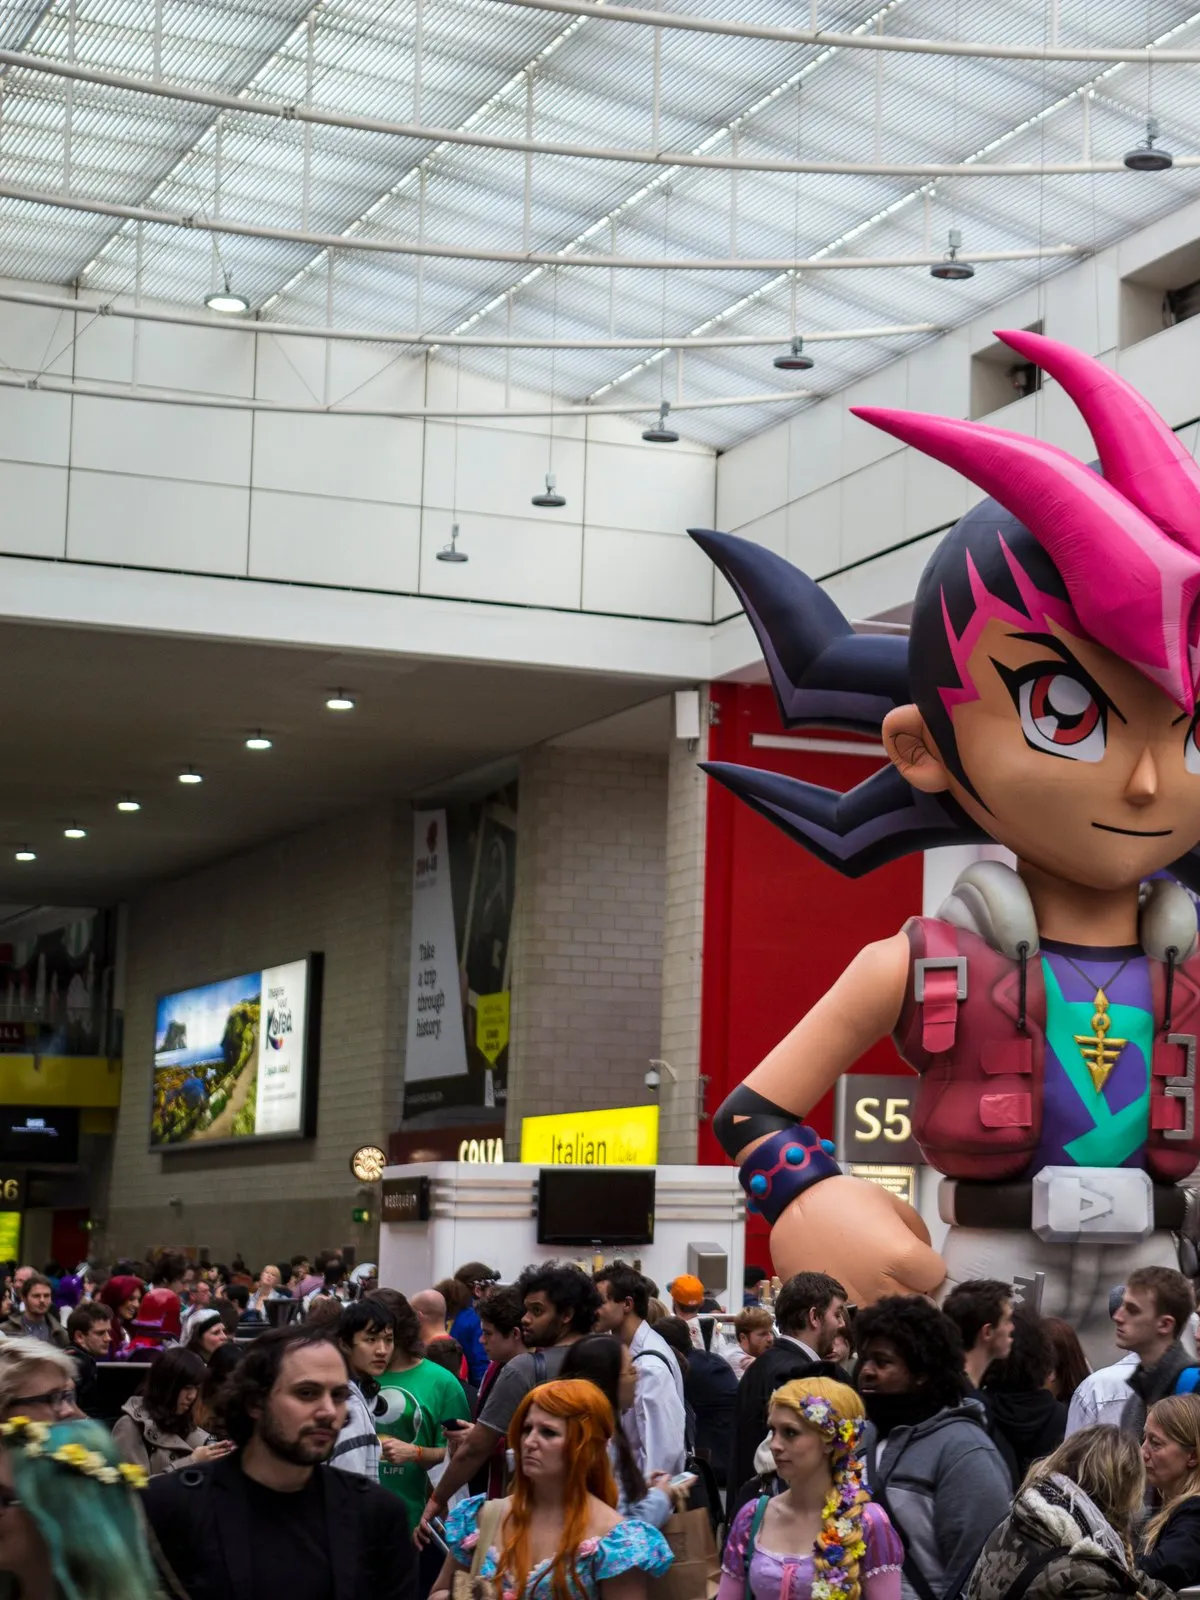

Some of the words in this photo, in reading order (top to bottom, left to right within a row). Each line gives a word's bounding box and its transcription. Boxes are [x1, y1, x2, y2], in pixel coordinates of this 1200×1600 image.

[419, 942, 435, 961] Take
[417, 989, 445, 1013] through
[855, 1097, 911, 1142] S5
[552, 1132, 606, 1165] Italian
[0, 1179, 19, 1201] 6
[384, 1466, 404, 1474] LIFE
